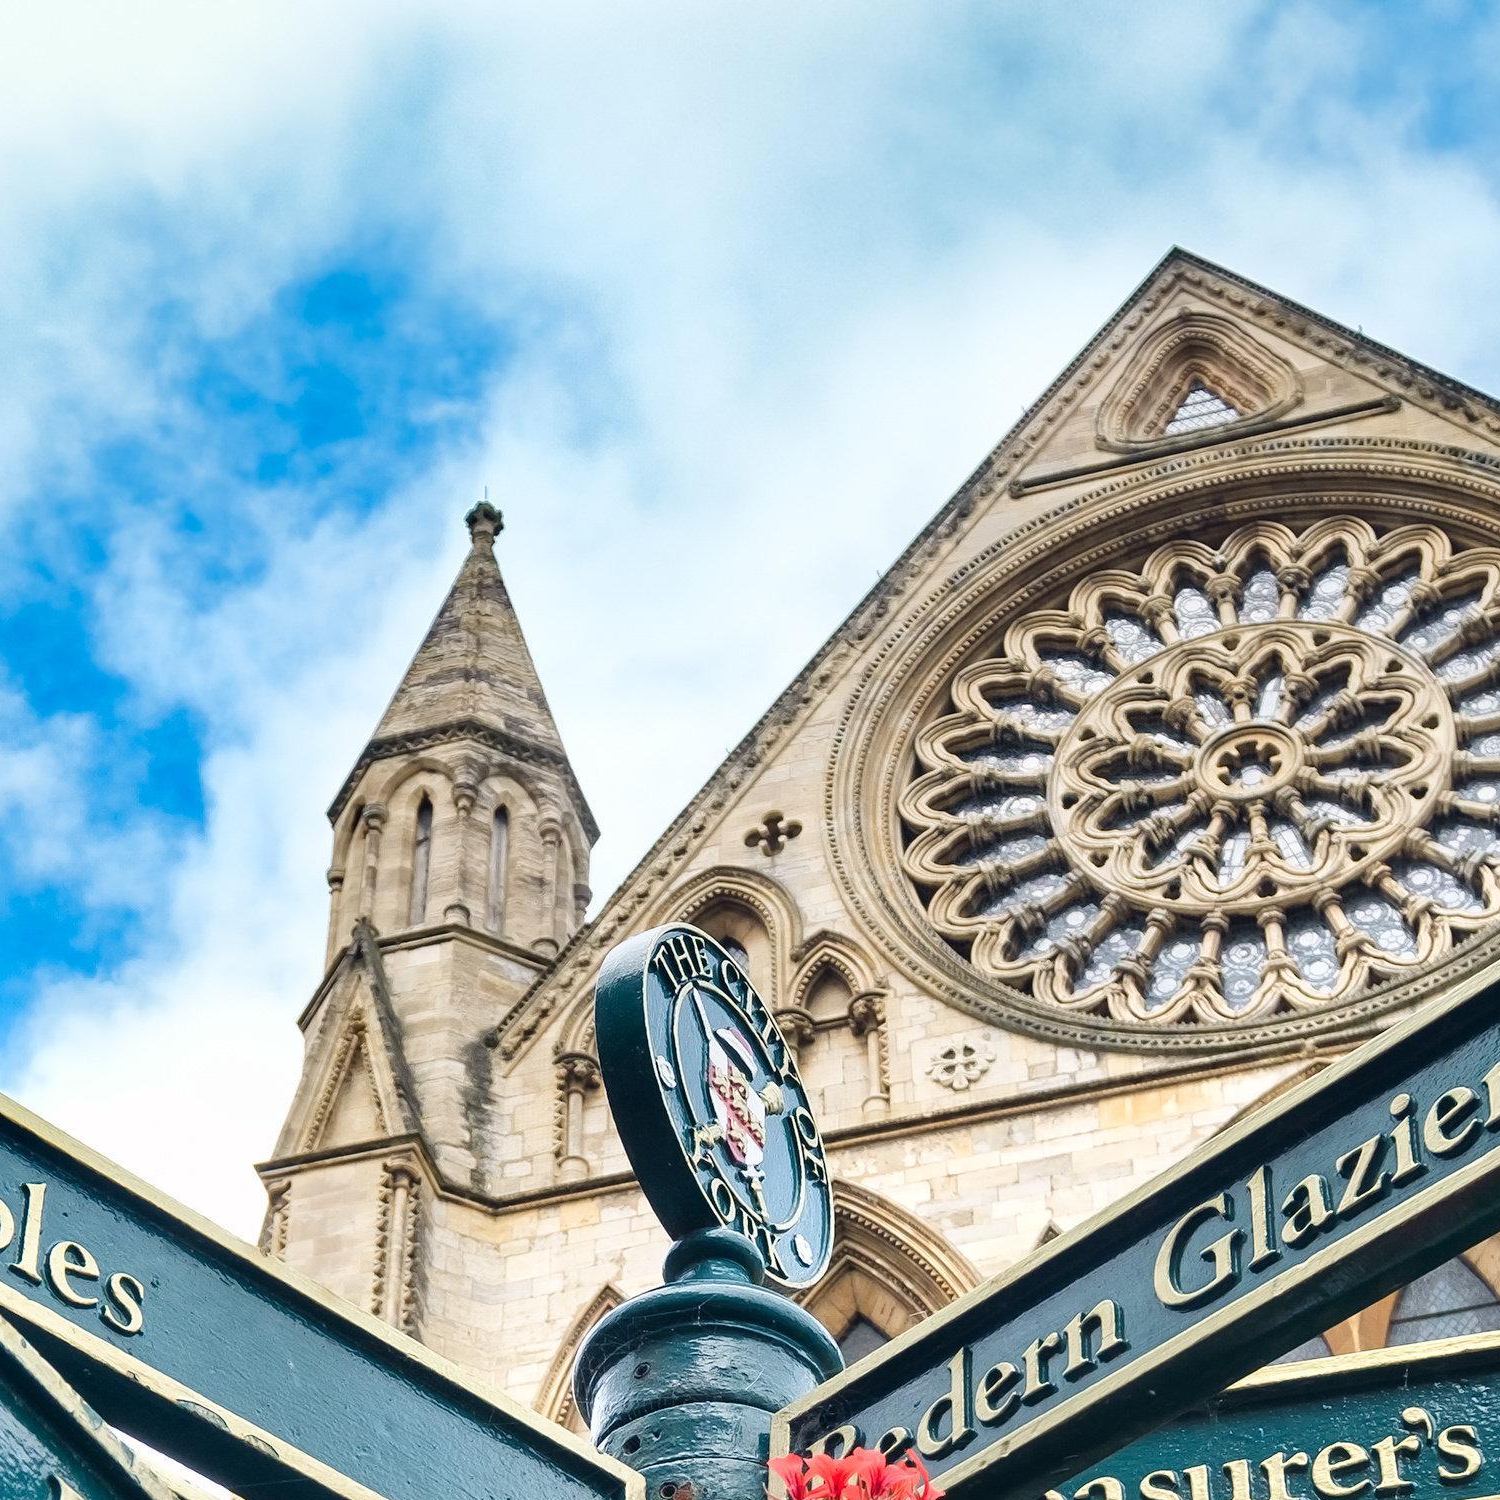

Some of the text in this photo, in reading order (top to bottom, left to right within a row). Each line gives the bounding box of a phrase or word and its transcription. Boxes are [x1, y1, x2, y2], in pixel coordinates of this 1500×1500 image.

[655, 937, 827, 1280] THE CITY OF YORK
